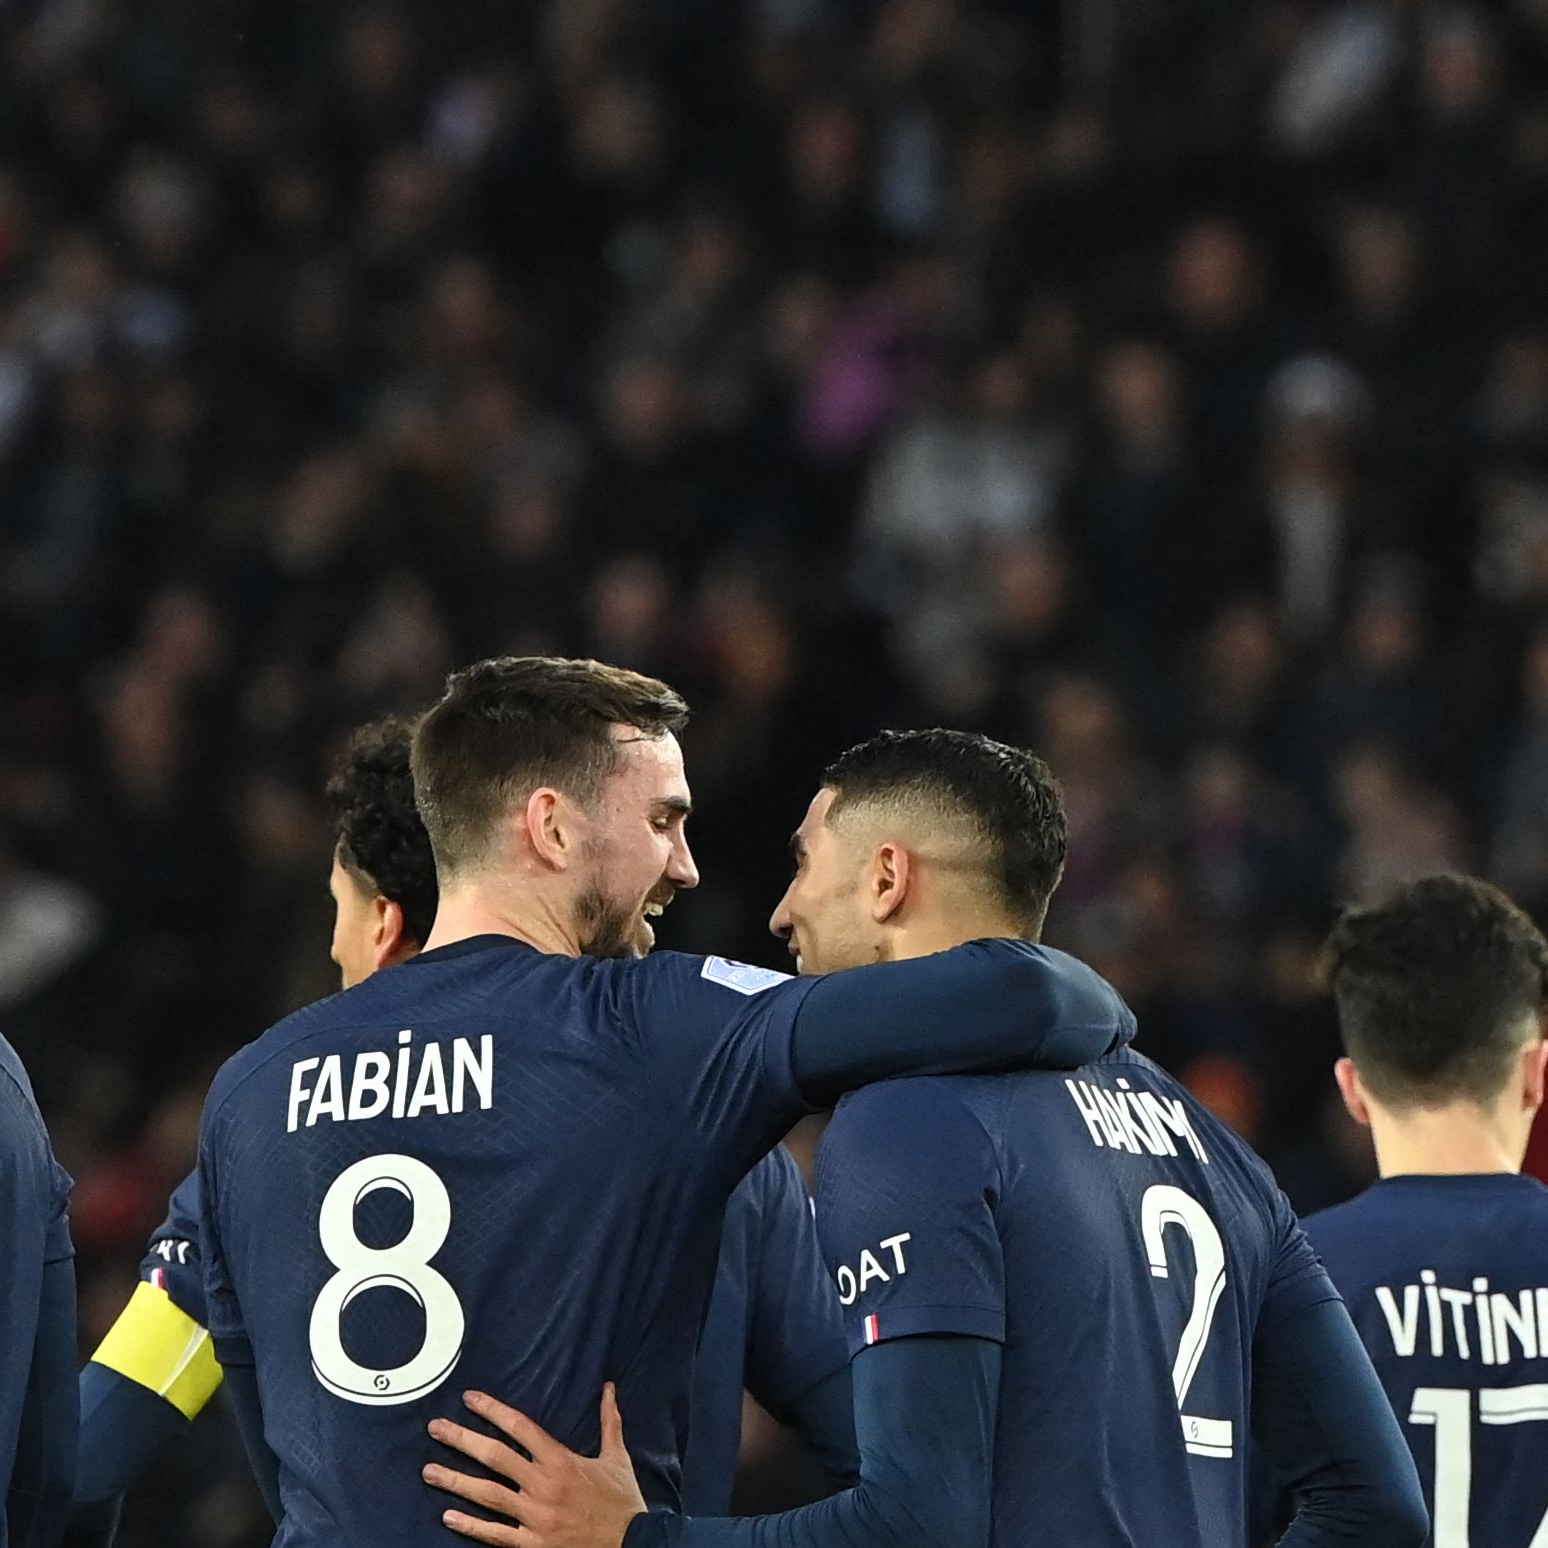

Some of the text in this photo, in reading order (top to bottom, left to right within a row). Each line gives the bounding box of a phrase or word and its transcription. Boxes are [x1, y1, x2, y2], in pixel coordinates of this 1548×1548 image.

[287, 1029, 494, 1133] FABIAN
[310, 1153, 465, 1406] 8
[1141, 1184, 1233, 1459] 2
